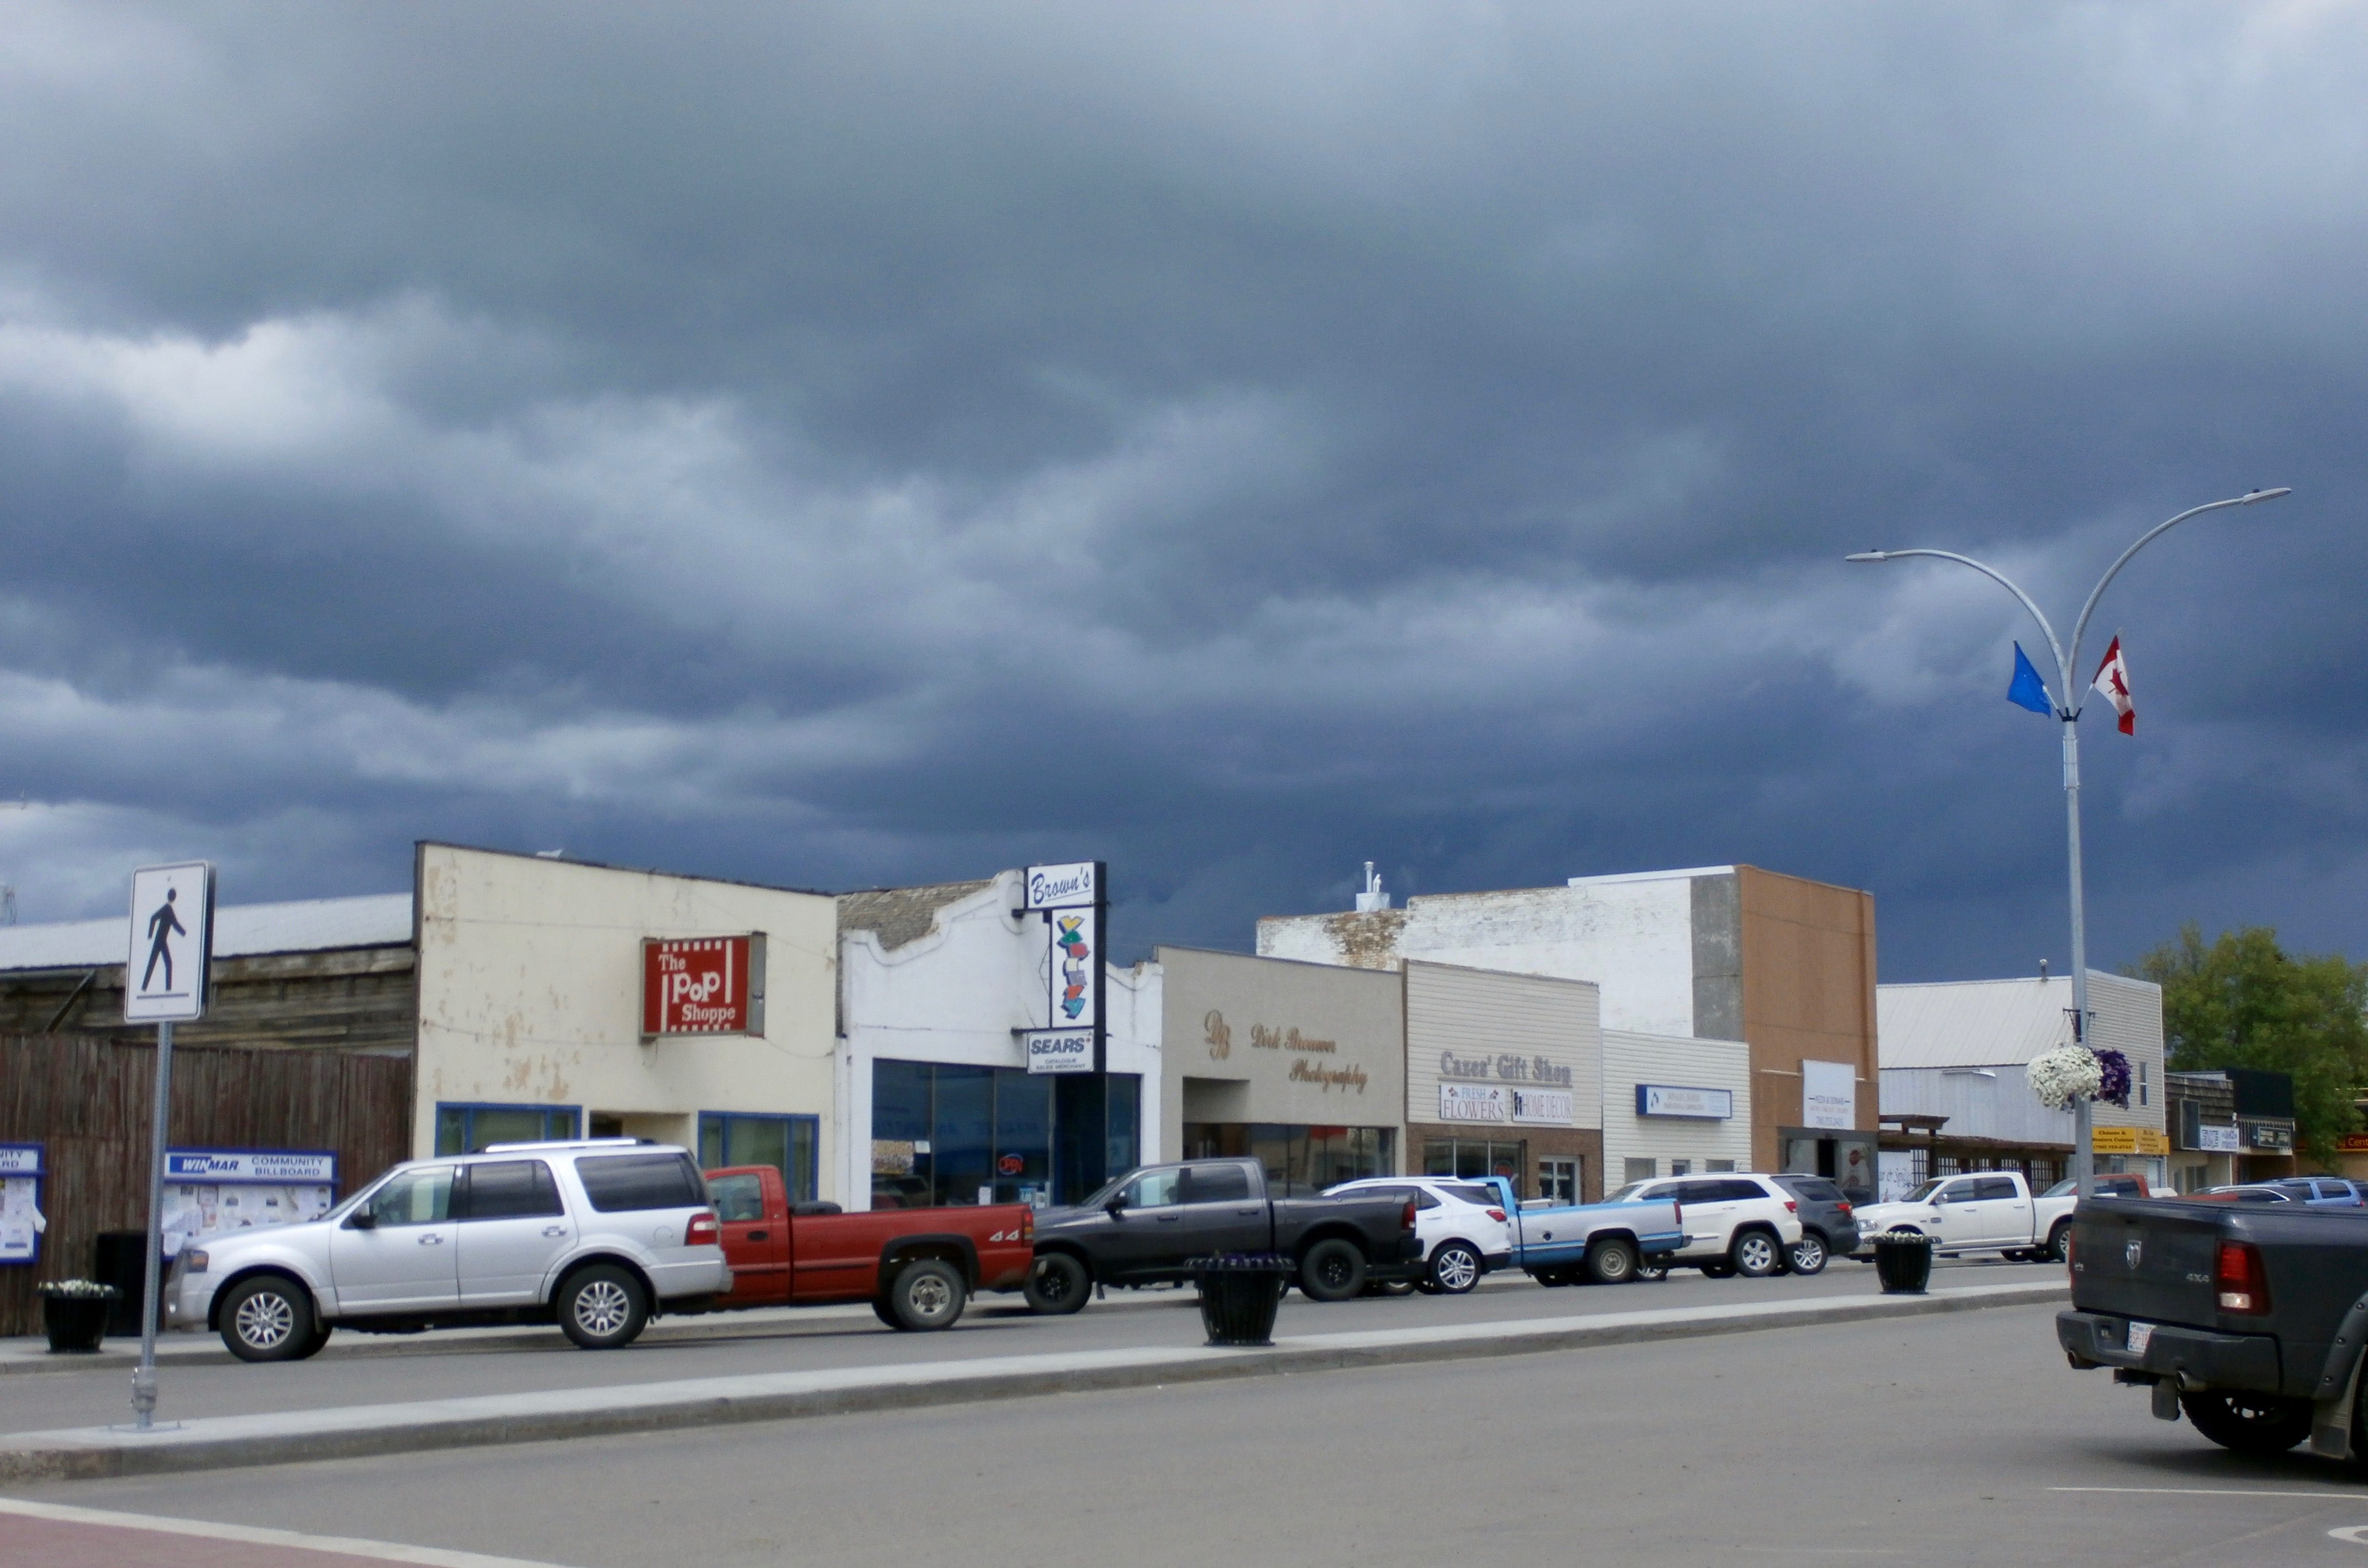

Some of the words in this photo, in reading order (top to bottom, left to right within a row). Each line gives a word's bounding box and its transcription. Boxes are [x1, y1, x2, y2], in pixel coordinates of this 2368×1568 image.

[1031, 866, 1091, 904] Brown's
[658, 954, 686, 971] The
[681, 1004, 736, 1023] Shoppe
[1031, 1038, 1084, 1055] SEARS
[1289, 1058, 1367, 1094] Photography
[1497, 1054, 1527, 1080] Gift
[1532, 1055, 1572, 1087] Shop
[1461, 1087, 1486, 1100] FRESH
[1444, 1099, 1504, 1120] FLOWERS
[1522, 1094, 1544, 1117] HOME
[1546, 1095, 1572, 1118] DECOR
[182, 1158, 239, 1172] WINMAR
[251, 1157, 324, 1166] COMMUNITY
[998, 1156, 1023, 1172] OPEN
[255, 1168, 320, 1176] BILLBOARD
[989, 1229, 1020, 1242] 44
